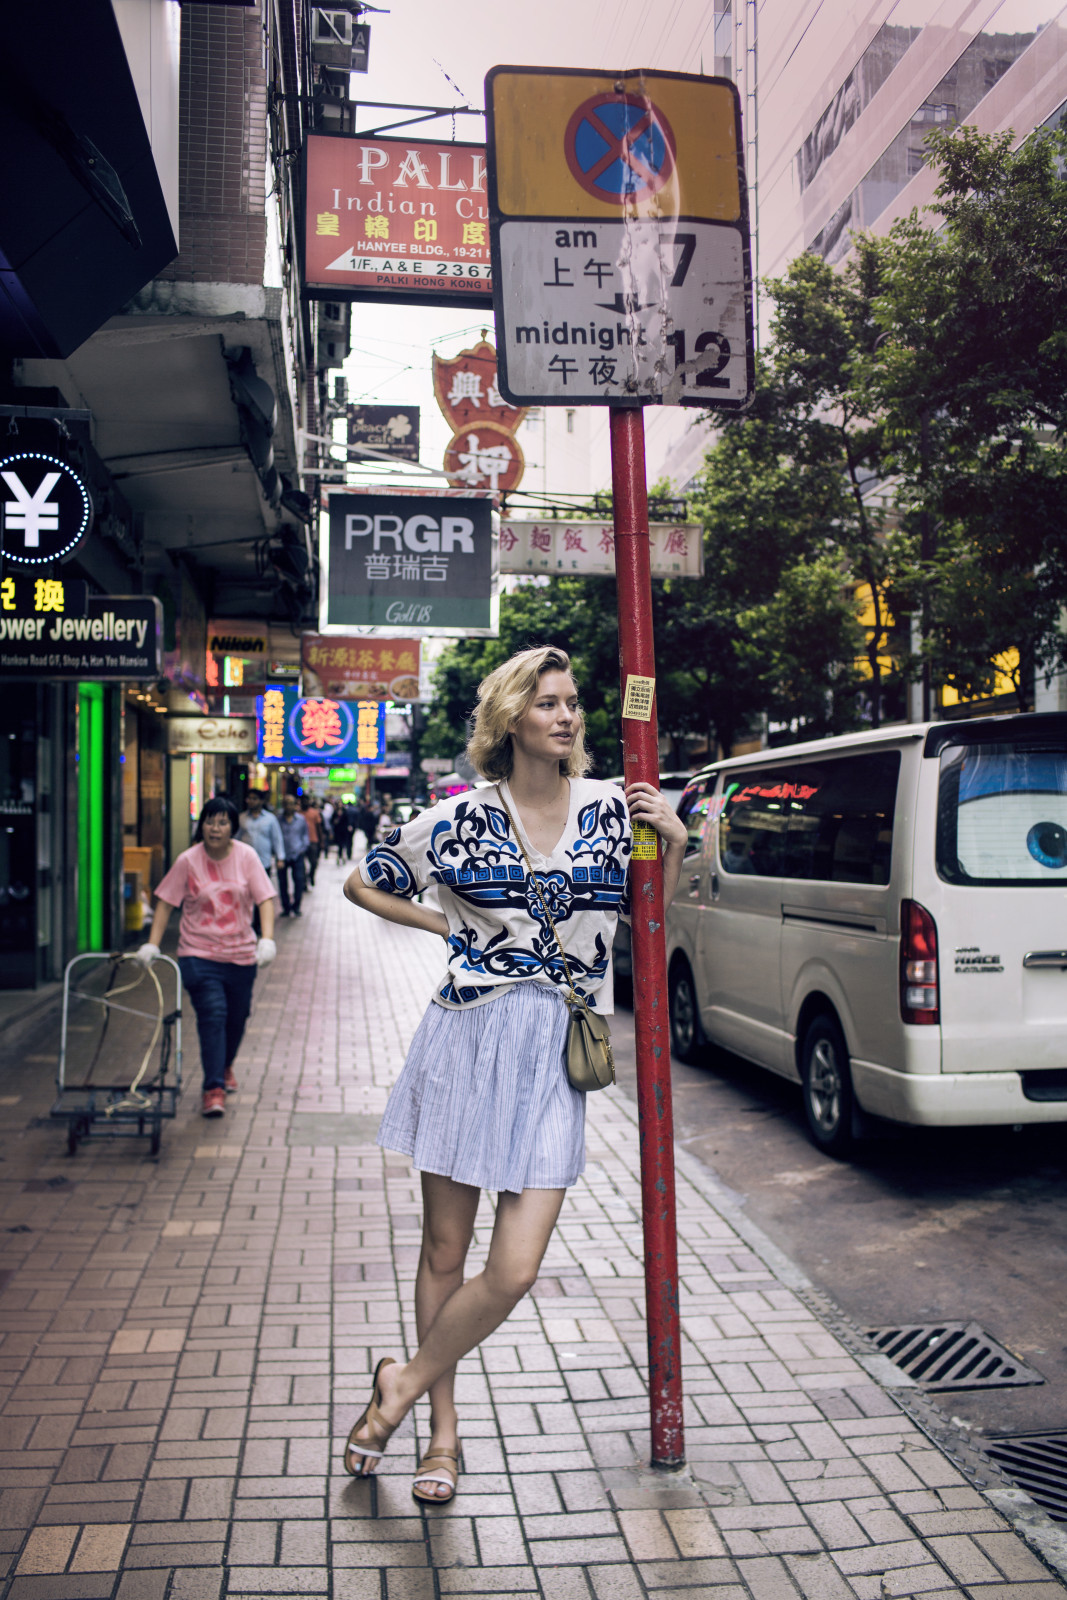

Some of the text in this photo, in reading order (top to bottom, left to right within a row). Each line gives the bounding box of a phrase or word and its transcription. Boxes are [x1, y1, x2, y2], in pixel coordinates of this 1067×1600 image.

[332, 189, 436, 216] Indian
[357, 241, 407, 253] HANYEE
[410, 244, 449, 257] BLDG.,
[453, 247, 482, 258] 19-21
[555, 228, 597, 248] am
[350, 258, 491, 278] 1/F., A & E 2367
[543, 257, 614, 289] 上午
[659, 233, 697, 287] 7
[377, 275, 408, 285] PALKI
[414, 277, 445, 287] HONG
[450, 279, 481, 289] KONG
[515, 322, 647, 349] midnight
[548, 354, 619, 386] 午夜
[666, 330, 731, 389] 12
[457, 433, 512, 490] 押
[0, 471, 62, 547] ¥
[345, 514, 474, 553] PRGR
[500, 525, 688, 556] 粉麵飯茶廳
[365, 553, 449, 581] 普瑞吉
[50, 612, 148, 649] Jewellery
[211, 636, 264, 652] Nikon
[197, 719, 249, 740] Echo
